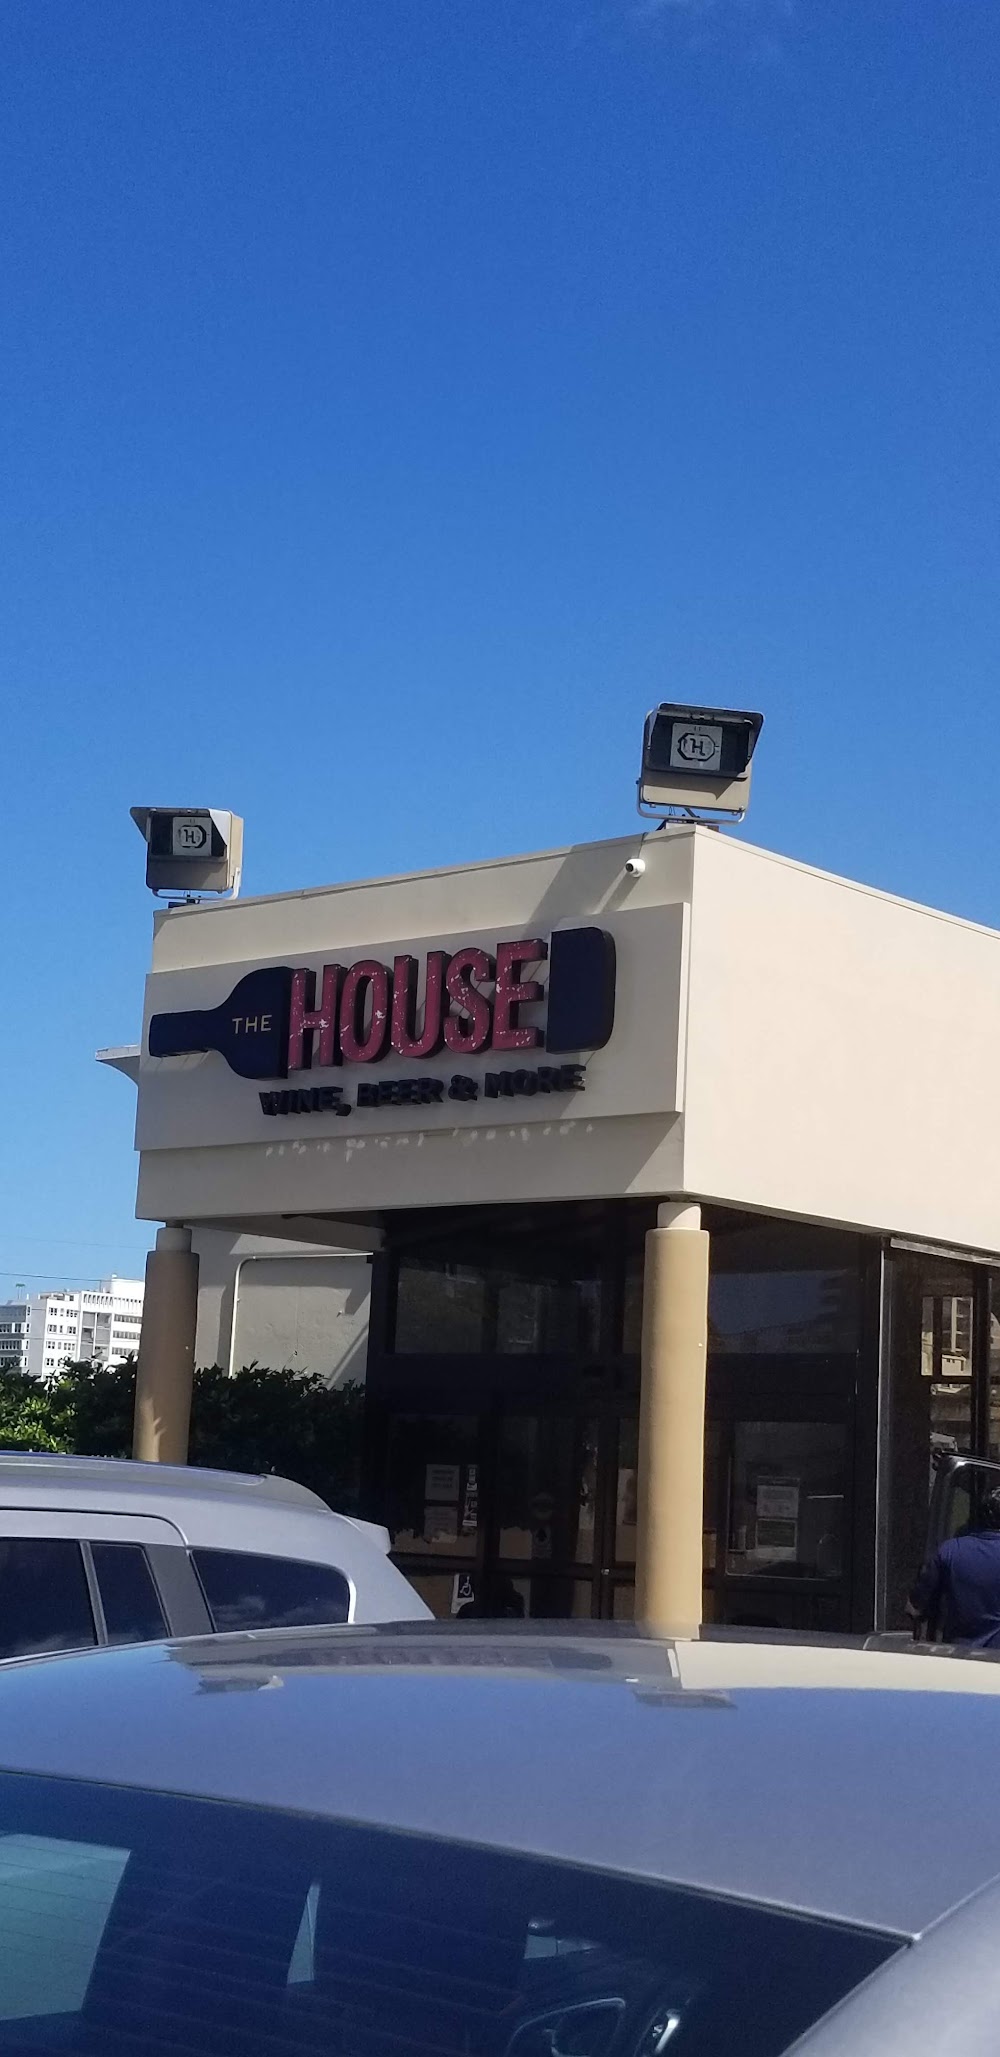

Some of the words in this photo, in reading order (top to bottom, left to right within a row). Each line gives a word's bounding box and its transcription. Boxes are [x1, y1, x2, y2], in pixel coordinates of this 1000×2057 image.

[690, 738, 706, 756] H
[231, 1014, 274, 1034] THE
[288, 939, 549, 1070] HOUSE
[259, 1086, 352, 1116] WINE,
[357, 1077, 446, 1107] BEER
[449, 1074, 479, 1101] &
[485, 1064, 587, 1098] MORE
